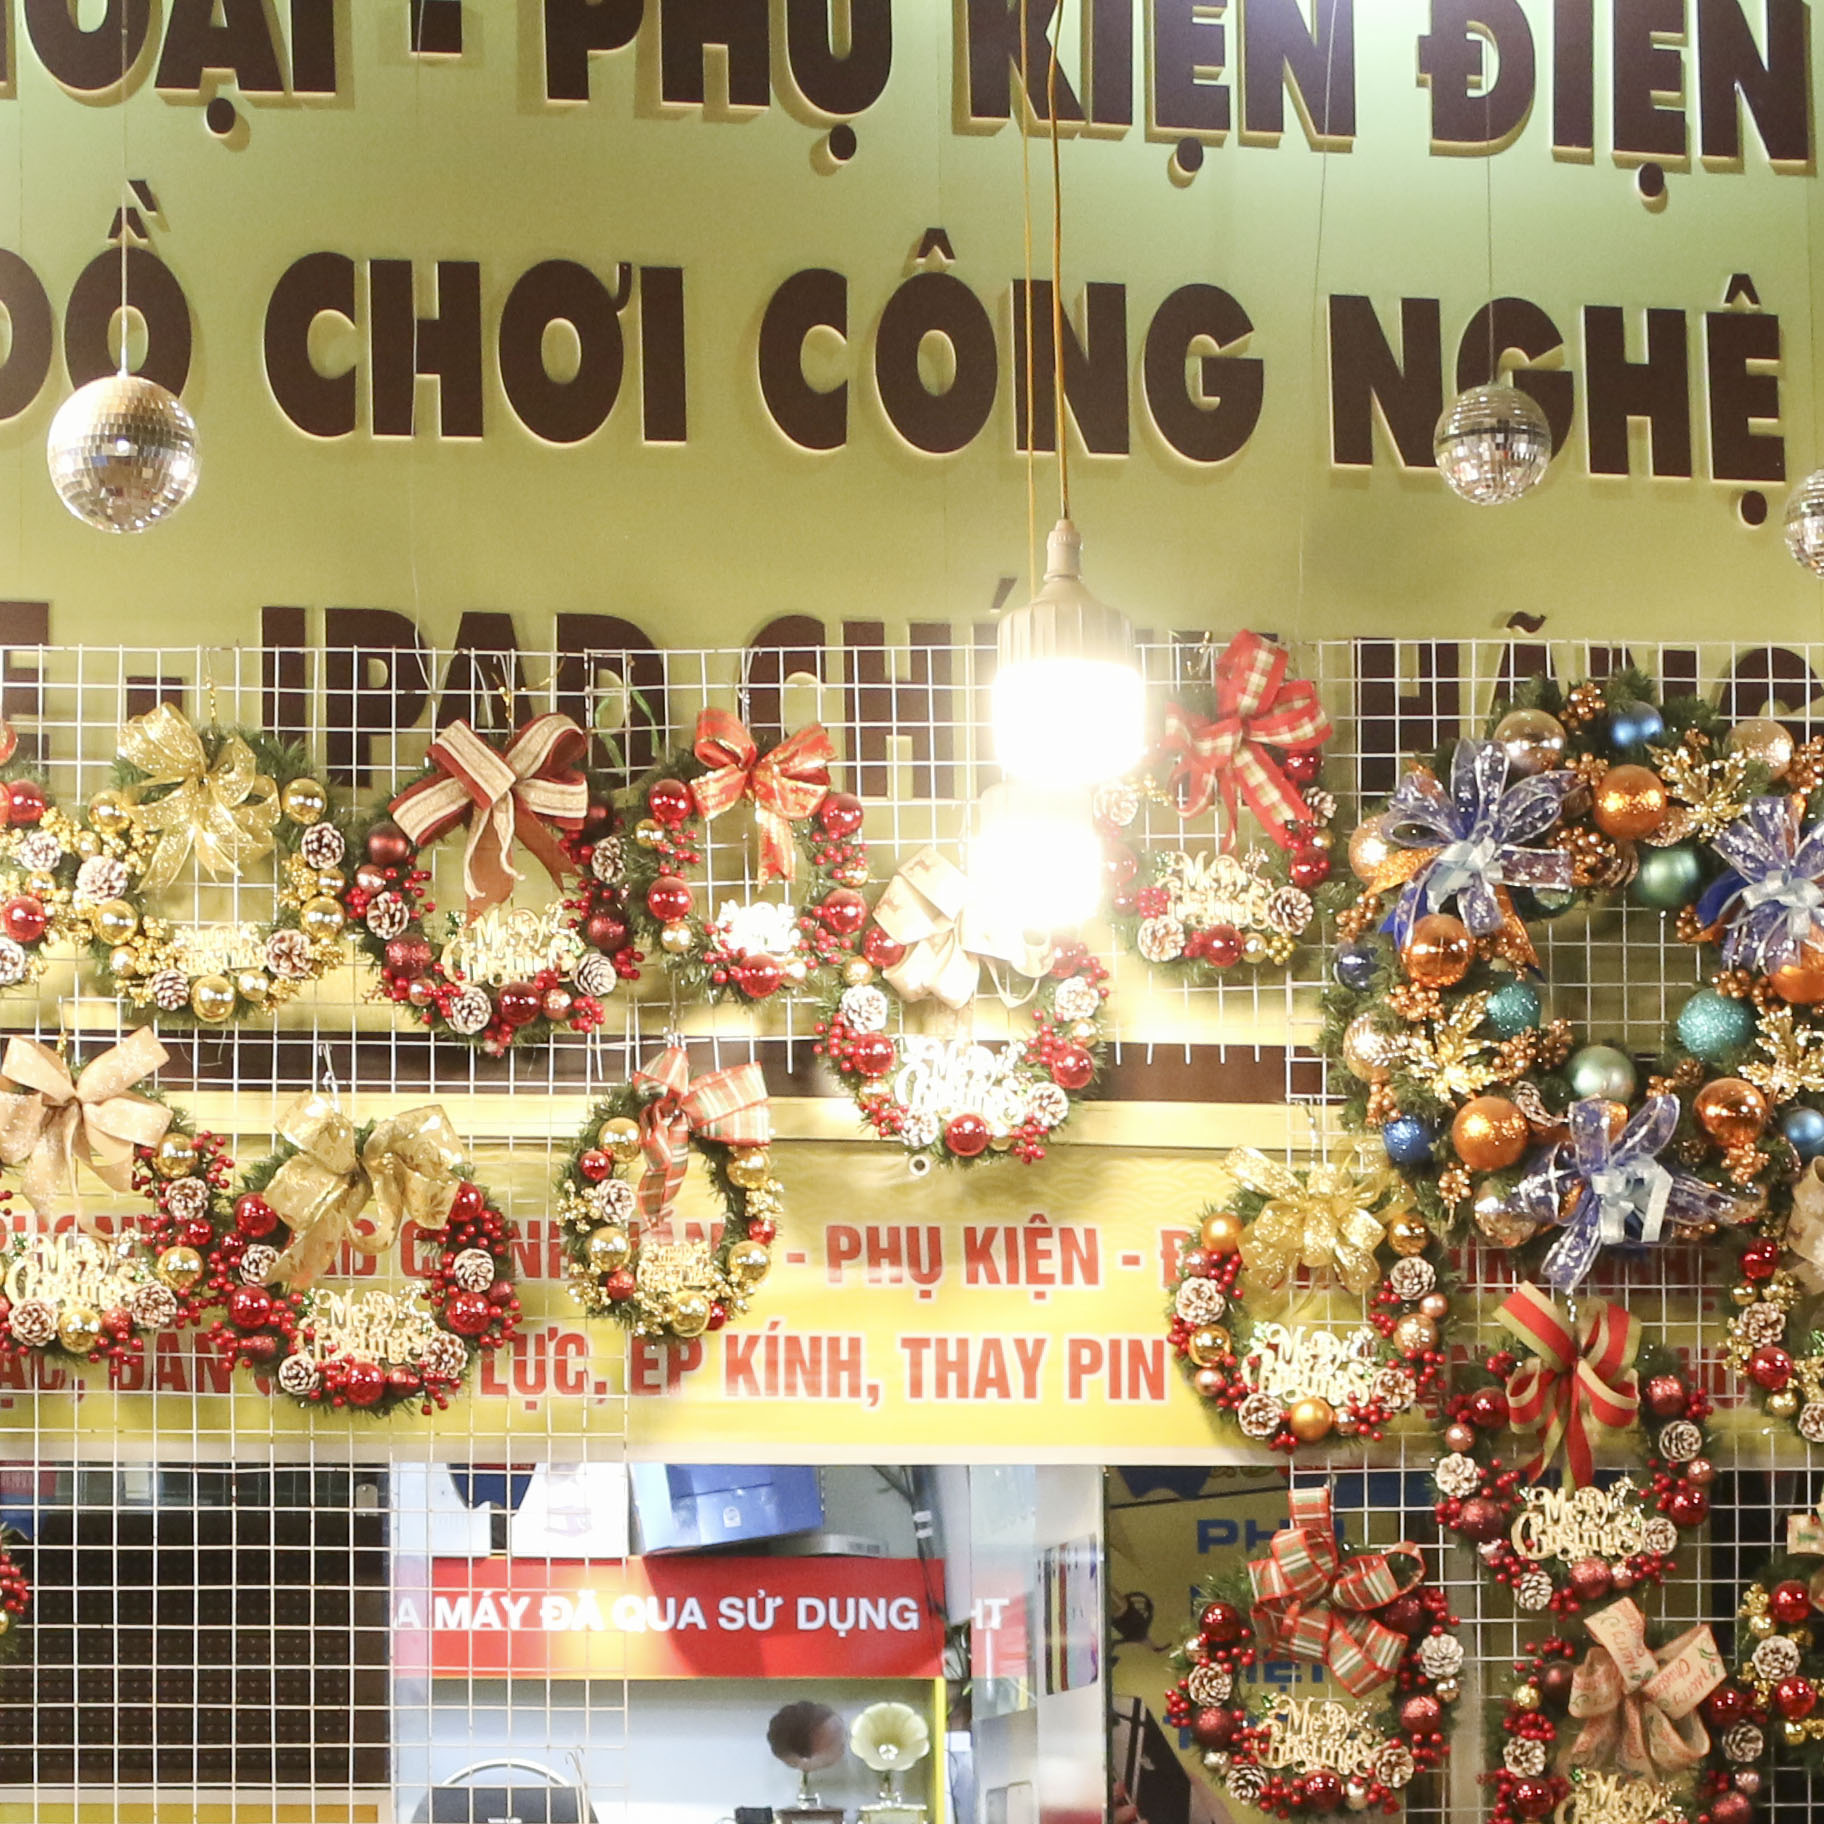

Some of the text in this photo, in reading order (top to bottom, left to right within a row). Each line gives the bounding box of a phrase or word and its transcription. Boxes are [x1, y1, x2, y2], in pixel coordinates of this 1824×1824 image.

[545, 0, 892, 162] PHỤ
[1416, 0, 1810, 199] ĐIỆN
[264, 250, 686, 446] CHƠI
[758, 228, 1264, 465] CÔNG
[1328, 272, 1787, 527] NGHỆ
[826, 1225, 943, 1299] PHỤ
[963, 1213, 1099, 1301] KIỆN
[480, 1326, 607, 1411] LỰC,
[725, 1320, 880, 1407] KÍNH,
[899, 1337, 1046, 1400] THAY
[1068, 1337, 1165, 1400] PIN
[435, 1591, 530, 1631] MÁY
[611, 1595, 708, 1634] QUA
[719, 1588, 785, 1632] SỬ
[797, 1595, 920, 1638] DỤNG
